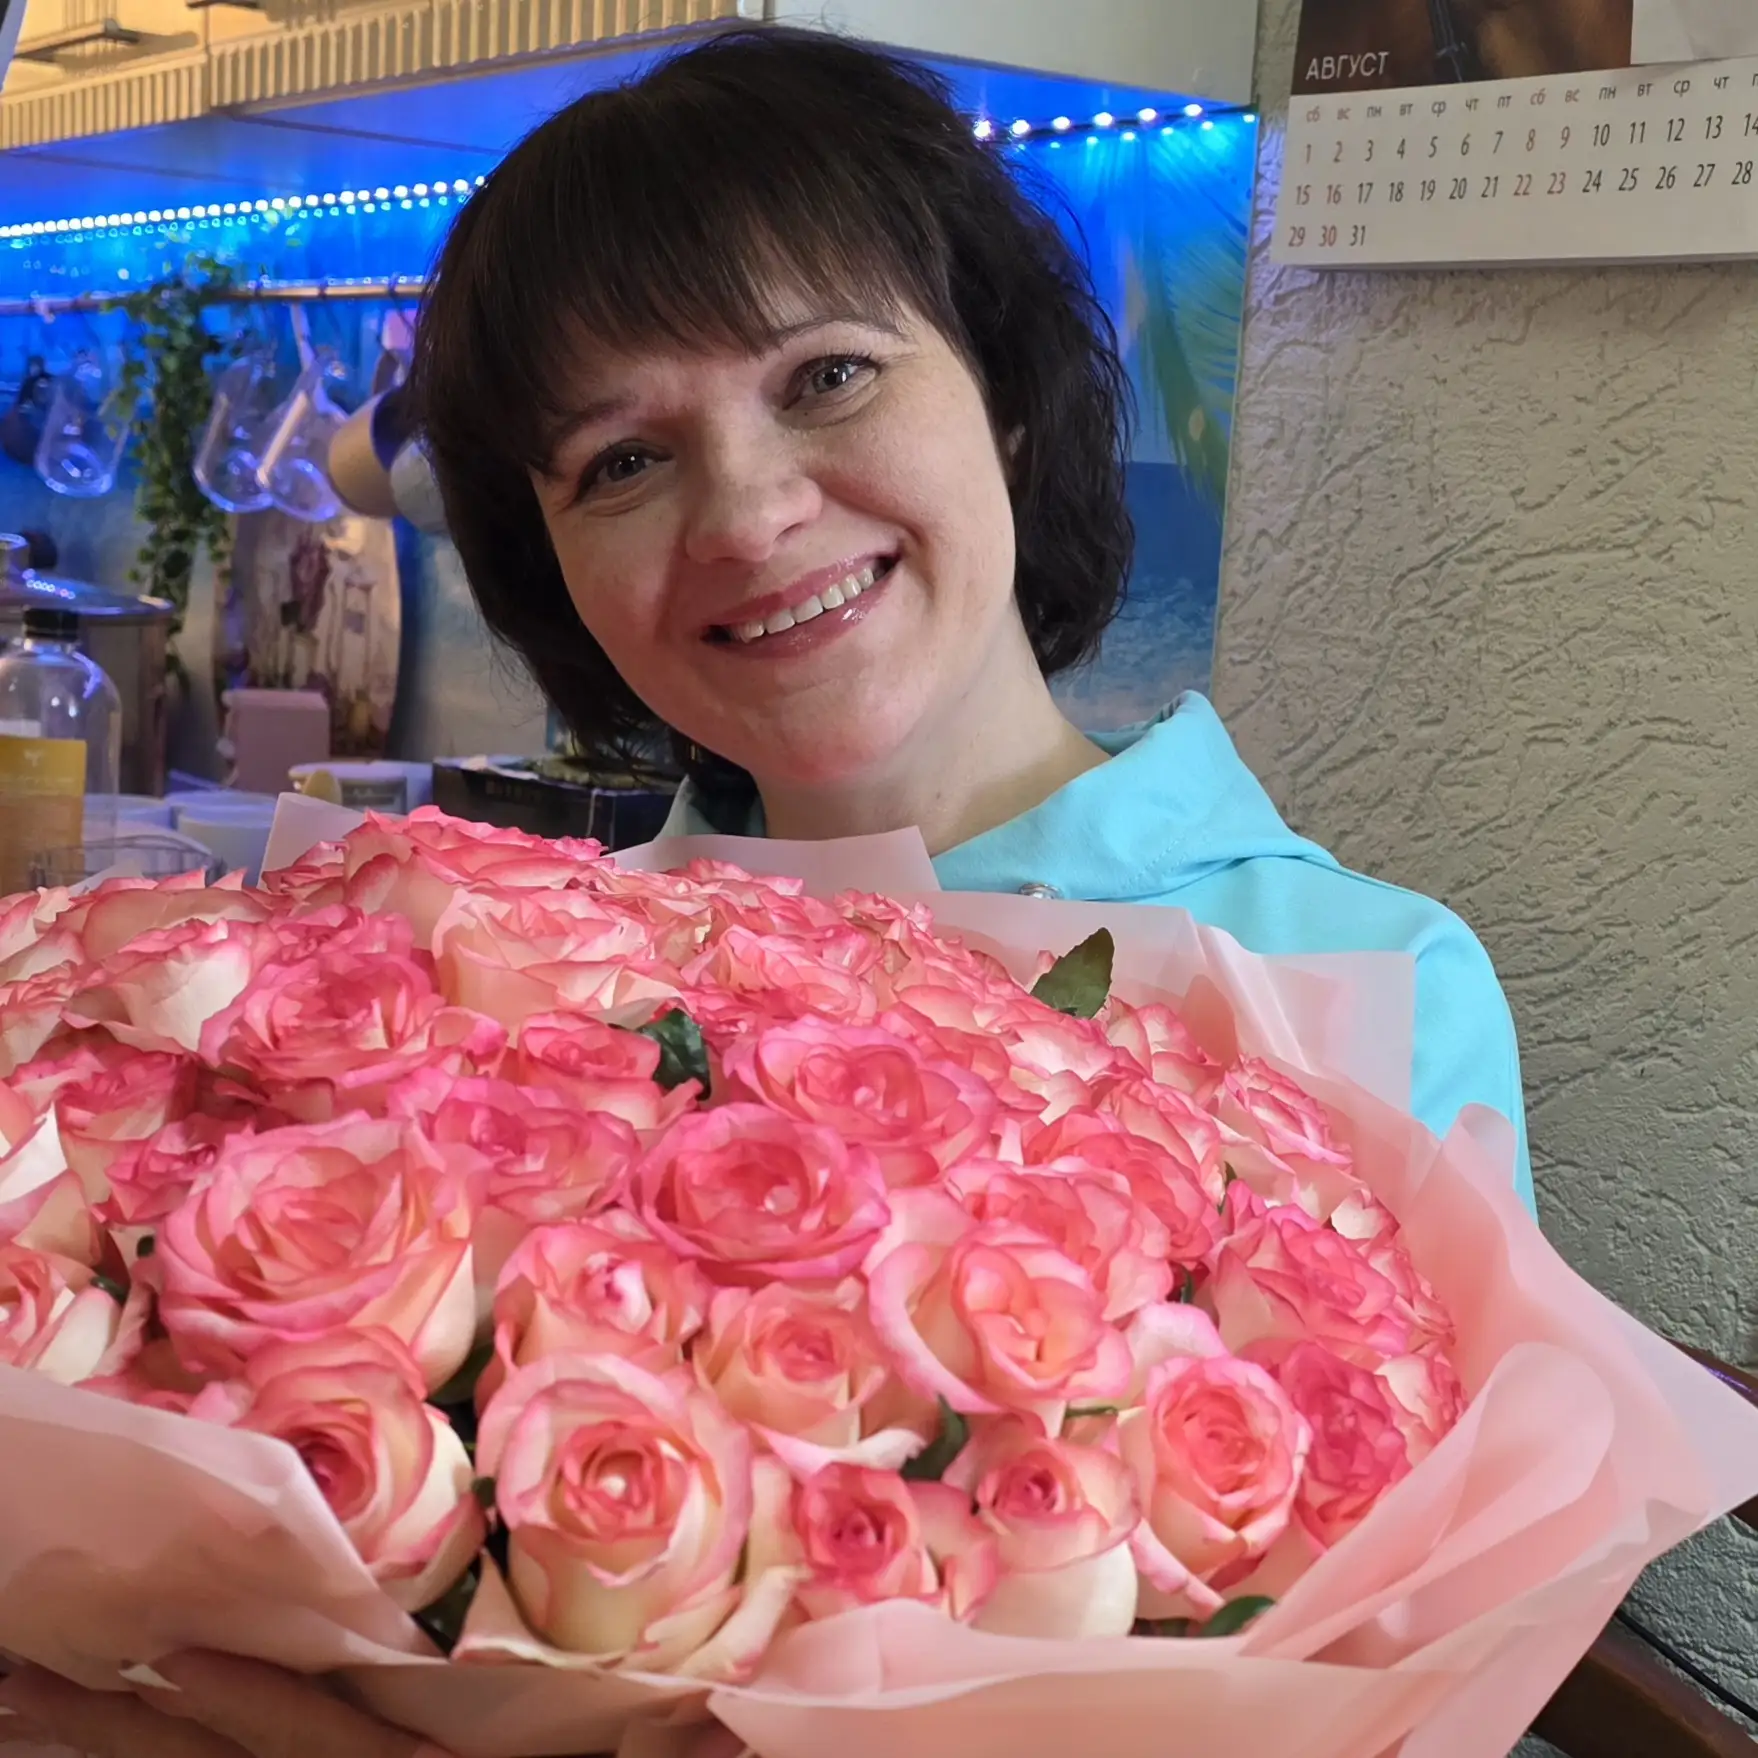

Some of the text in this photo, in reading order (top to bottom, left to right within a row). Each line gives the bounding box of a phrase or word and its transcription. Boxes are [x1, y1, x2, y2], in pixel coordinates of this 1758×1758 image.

[1306, 52, 1390, 81] АВГУСТ
[1305, 106, 1320, 123] сб
[1336, 108, 1351, 121] вс
[1366, 106, 1381, 118] пн
[1399, 104, 1413, 116] вт
[1431, 101, 1446, 118] ср
[1465, 99, 1479, 111] чт
[1497, 96, 1511, 108] пт
[1529, 88, 1546, 106] сб
[1564, 91, 1580, 104] вс
[1598, 87, 1616, 100] пн
[1637, 83, 1652, 97] вт
[1673, 80, 1690, 97] ср
[1713, 77, 1729, 89] чт
[1333, 141, 1343, 164] 2
[1364, 140, 1374, 162] 3
[1396, 139, 1406, 159] 4
[1428, 136, 1439, 159] 5
[1460, 134, 1471, 156] 6
[1493, 131, 1504, 154] 7
[1525, 129, 1536, 152] 8
[1560, 126, 1571, 150] 9
[1593, 124, 1610, 147] 10
[1629, 122, 1645, 144] 11
[1667, 118, 1684, 142] 12
[1705, 115, 1723, 140] 13
[1296, 161, 1753, 206] 15 16 17 18 19 20 21 22 23 24 25 26 27 28
[1288, 225, 1365, 248] 29 30 31
